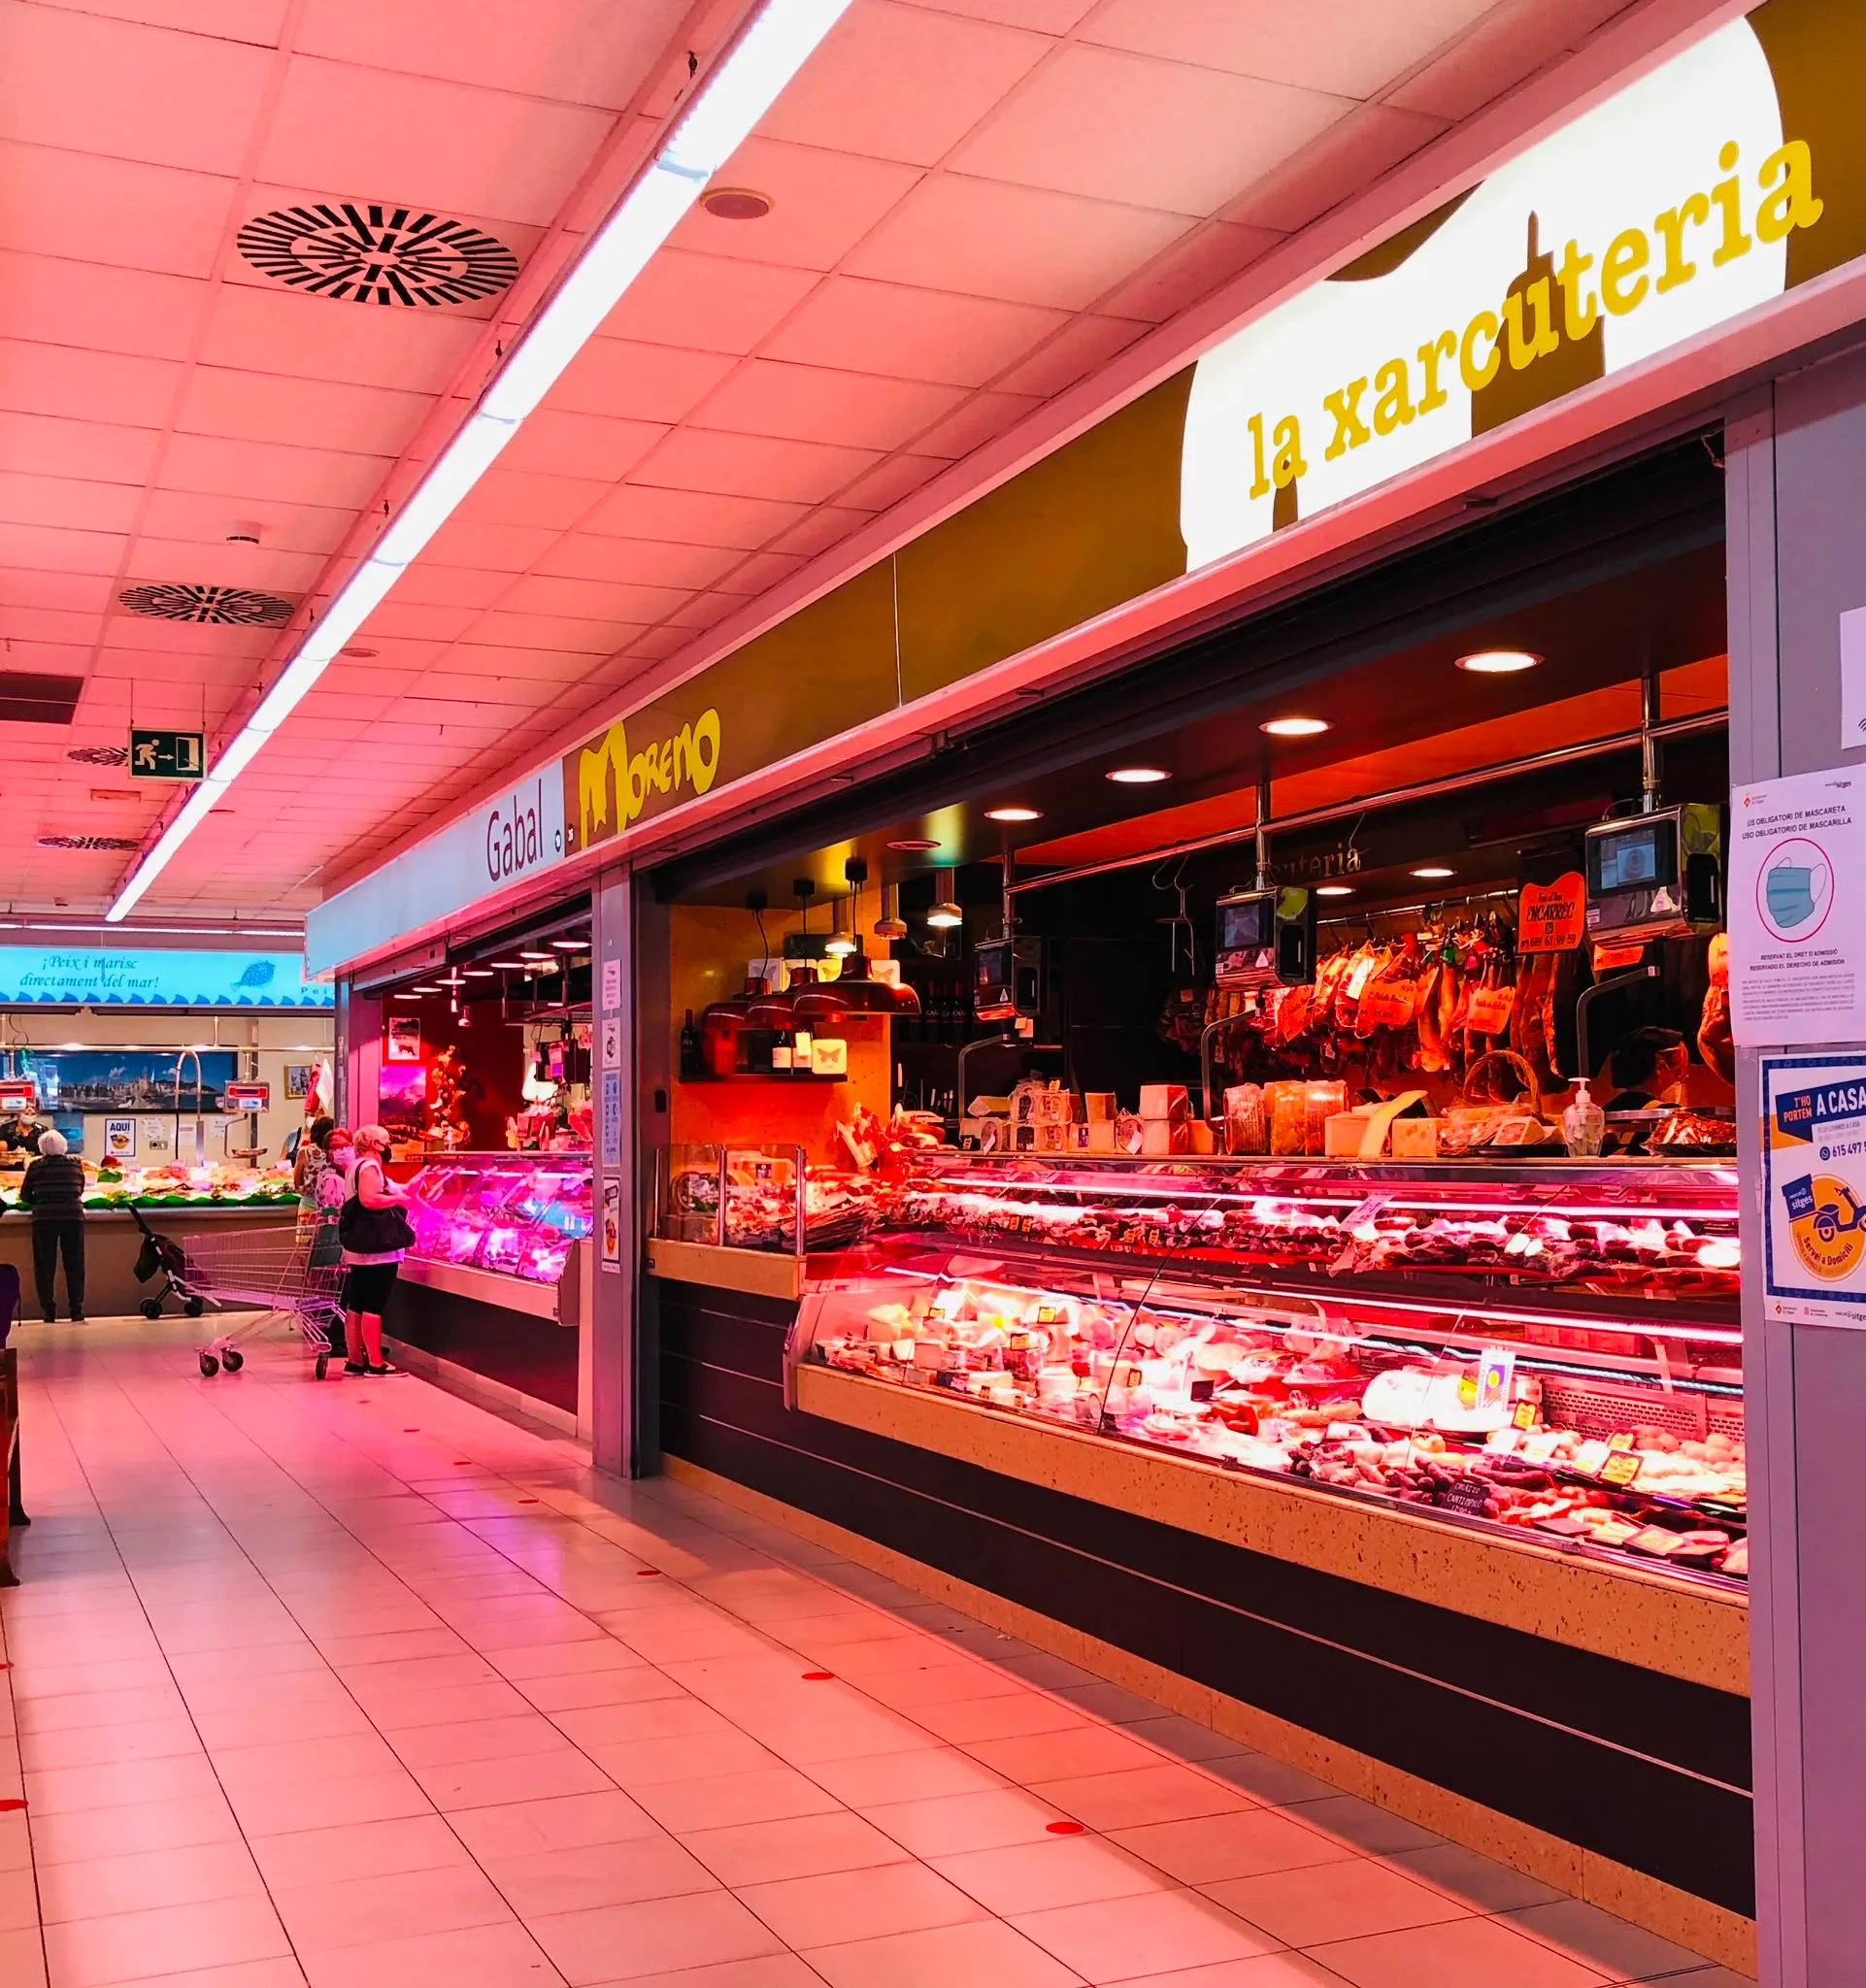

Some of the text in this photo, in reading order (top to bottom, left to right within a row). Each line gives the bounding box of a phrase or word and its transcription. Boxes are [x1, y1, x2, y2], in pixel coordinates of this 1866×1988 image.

[1247, 139, 1824, 501] la xarcuteria
[1755, 813, 1793, 826] OBLIGATORI
[1794, 812, 1804, 820] DE
[1805, 805, 1847, 818] MASCARETA
[486, 779, 545, 882] Gabal
[1742, 817, 1852, 840] USO OBLIGATORIO DE MASCARILLA
[83, 957, 89, 969] i
[94, 957, 138, 970] marisc
[19, 973, 159, 989] directament del mar!
[301, 986, 335, 995] Pei
[1794, 1085, 1866, 1116] T'HO A CASA
[1783, 1108, 1813, 1123] PORTEM
[1832, 1144, 1847, 1157] 615
[1848, 1142, 1862, 1155] 497
[1791, 1194, 1813, 1210] sitges
[1803, 1236, 1821, 1262] Servei
[1827, 1242, 1853, 1266] Domicili
[1851, 1312, 1866, 1322] sitge
